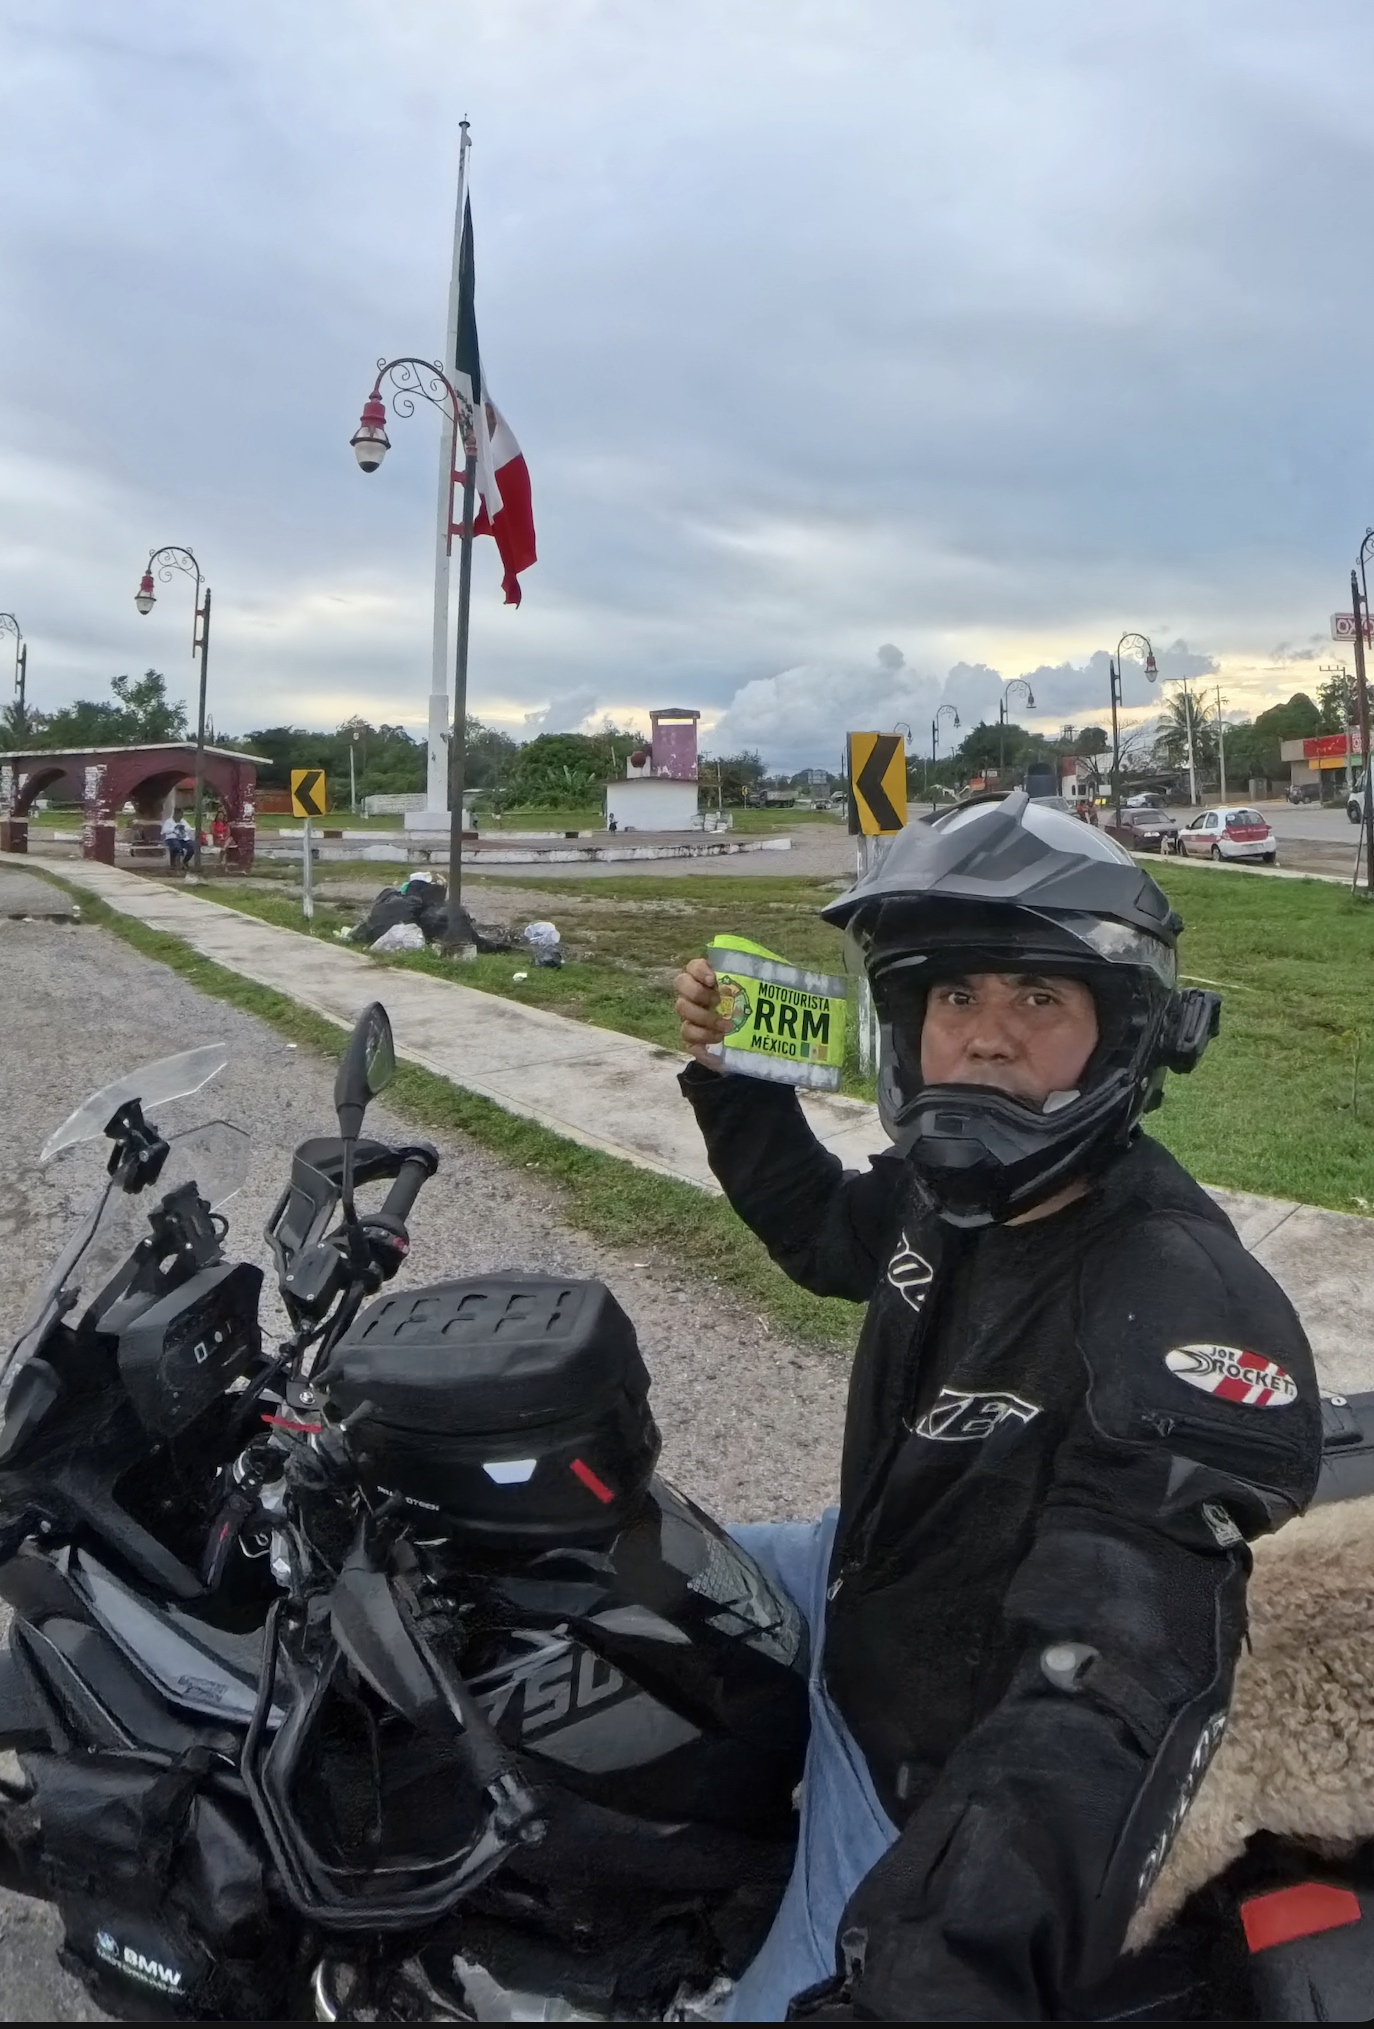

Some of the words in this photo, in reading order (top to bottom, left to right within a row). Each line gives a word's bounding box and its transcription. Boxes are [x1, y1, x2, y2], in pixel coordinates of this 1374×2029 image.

[1337, 617, 1374, 635] OXO
[758, 982, 830, 1012] MOTOTURISTA
[753, 997, 830, 1044] RRM
[751, 1034, 796, 1056] MÉXICO
[1210, 1347, 1236, 1361] JOE
[1212, 1358, 1295, 1394] ROCKET
[123, 1945, 182, 1986] BMW
